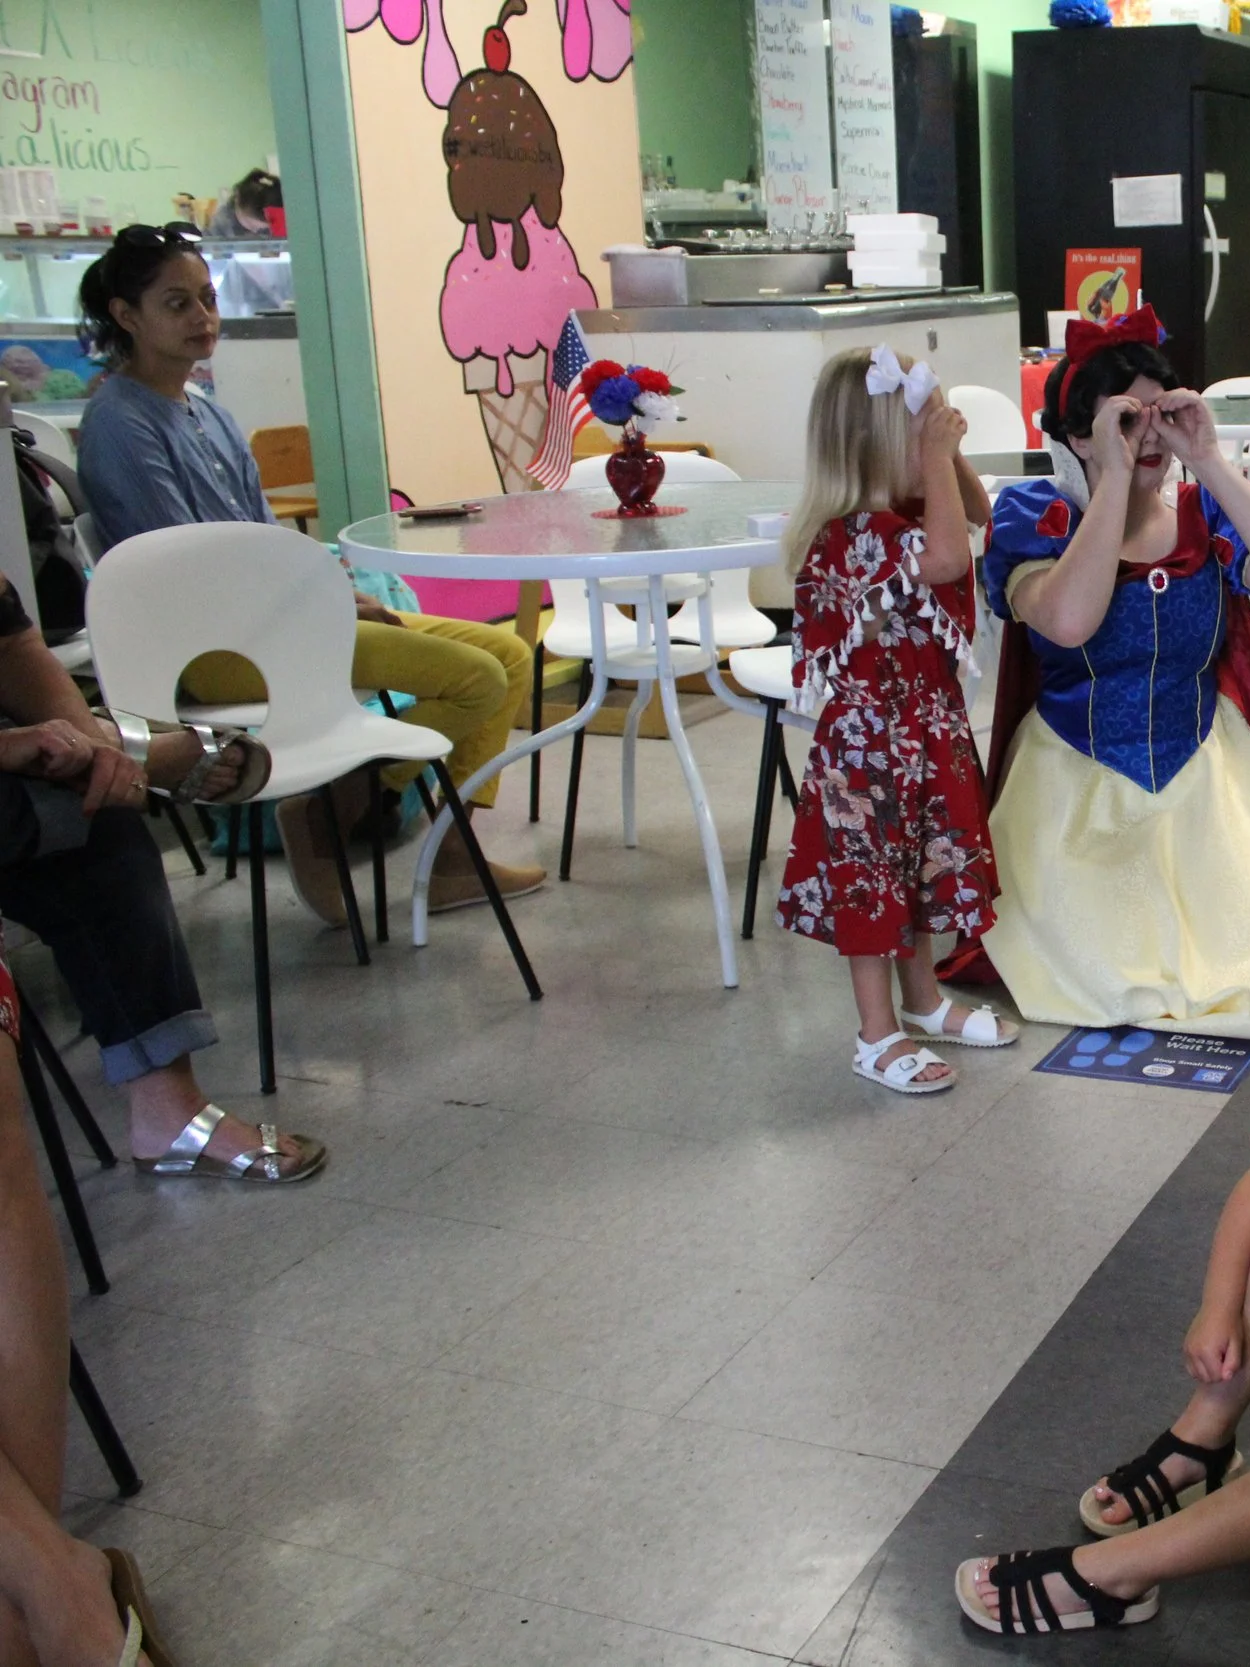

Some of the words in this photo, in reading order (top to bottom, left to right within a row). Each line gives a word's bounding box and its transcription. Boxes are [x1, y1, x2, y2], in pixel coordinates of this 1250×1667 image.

[1072, 252, 1084, 263] It's
[1085, 252, 1098, 263] the
[1117, 252, 1137, 265] thing
[1170, 1034, 1225, 1047] Please
[1166, 1041, 1204, 1052] Wait
[1206, 1045, 1247, 1056] Here
[1152, 1057, 1176, 1065] Shop
[1204, 1062, 1234, 1071] Safely
